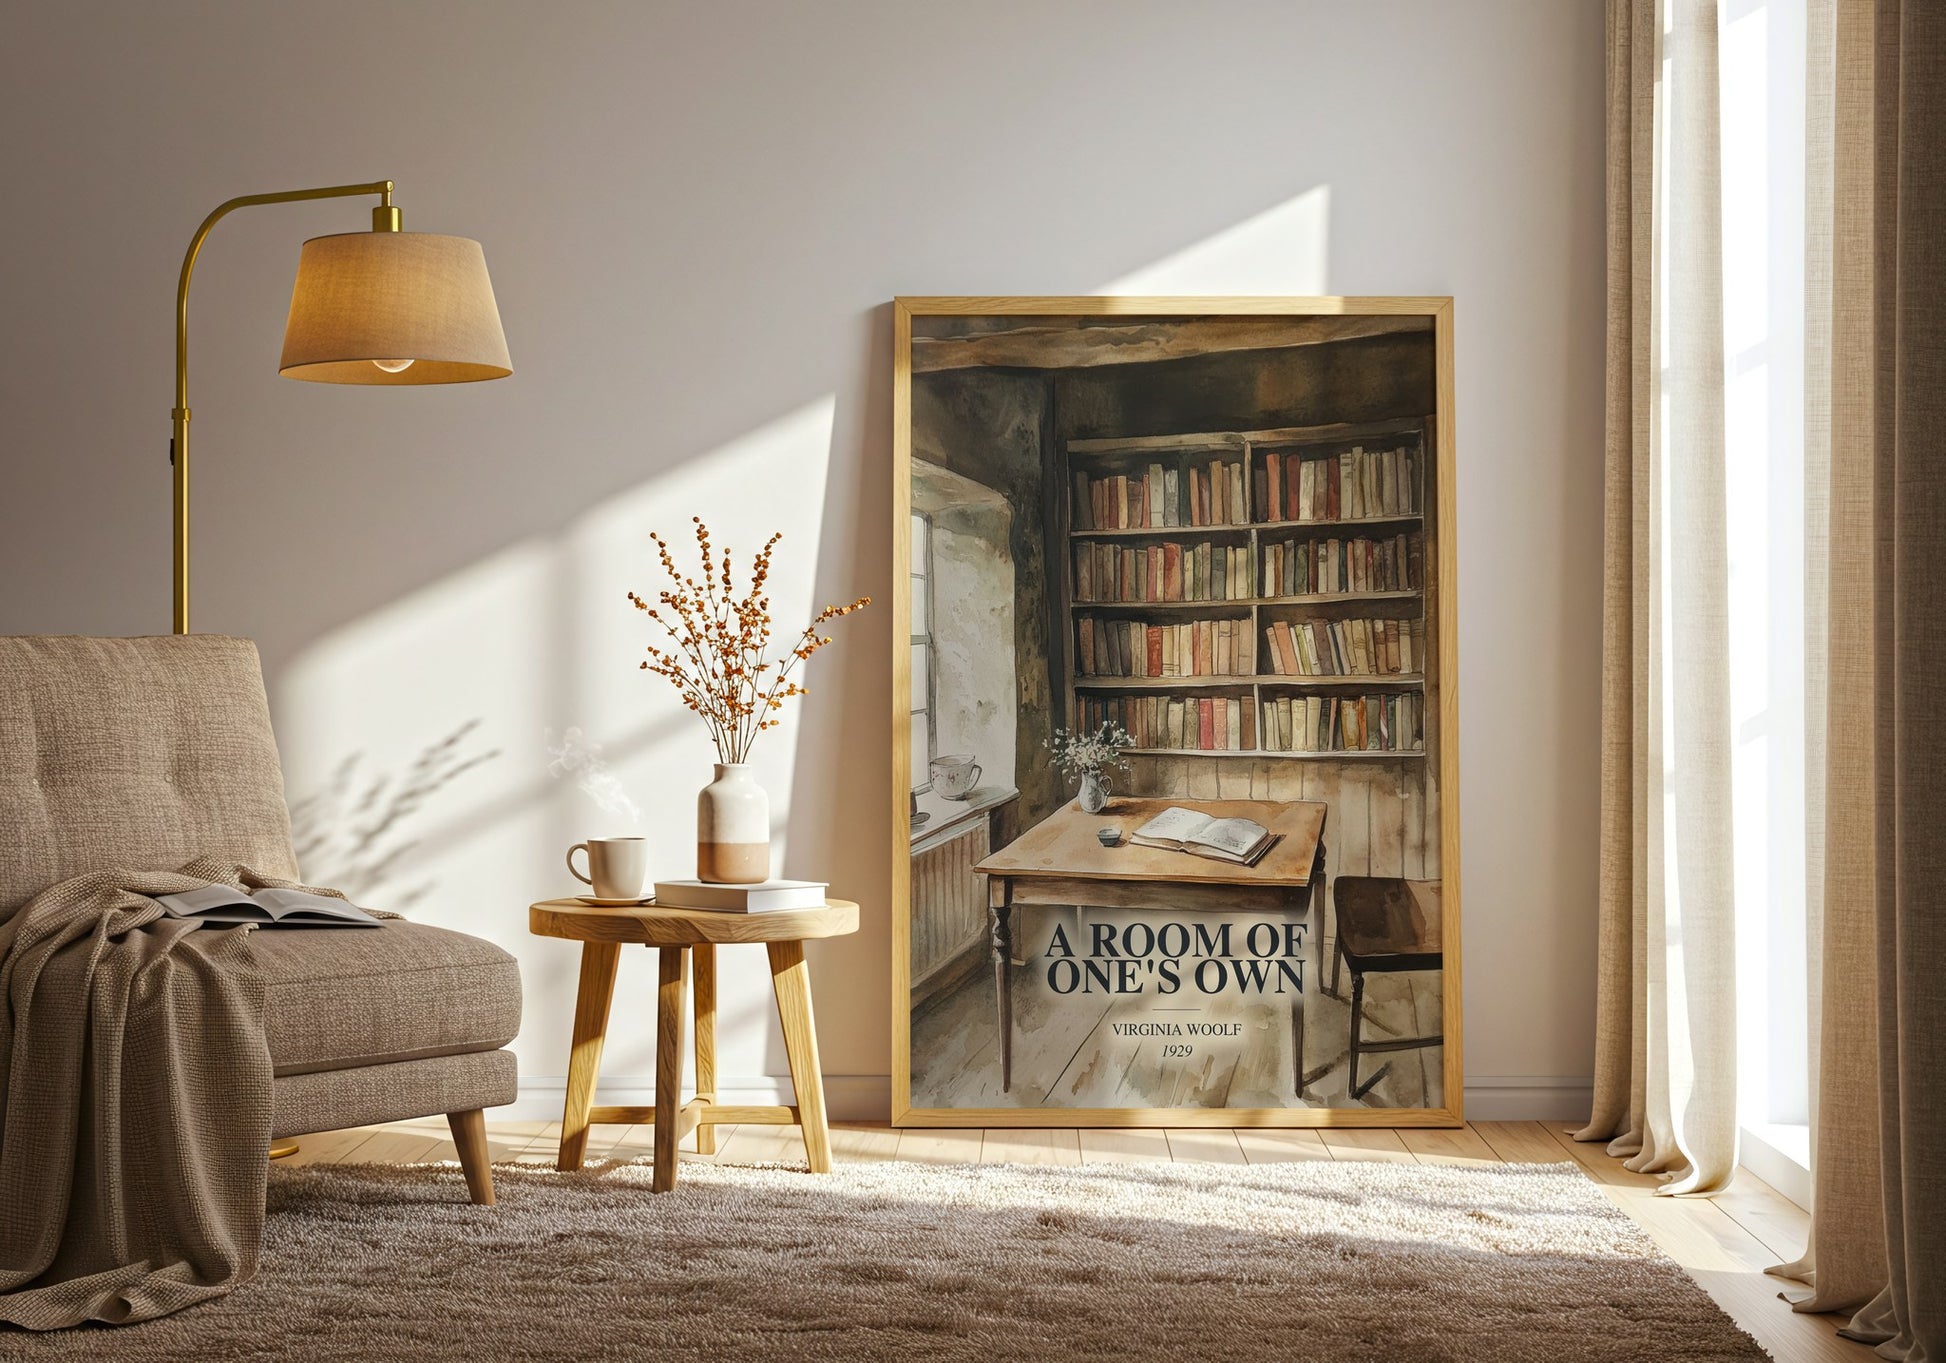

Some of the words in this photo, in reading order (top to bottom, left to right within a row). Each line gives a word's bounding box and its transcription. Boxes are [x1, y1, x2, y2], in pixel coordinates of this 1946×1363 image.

[1044, 923, 1076, 957] A
[1089, 923, 1234, 958] ROOM
[1246, 923, 1308, 958] OF
[1047, 959, 1181, 994] ONE'S
[1194, 959, 1306, 994] OWN
[1112, 1023, 1182, 1036] VIRGINIA
[1186, 1023, 1242, 1036] WOOLF
[1162, 1045, 1193, 1058] 1929
